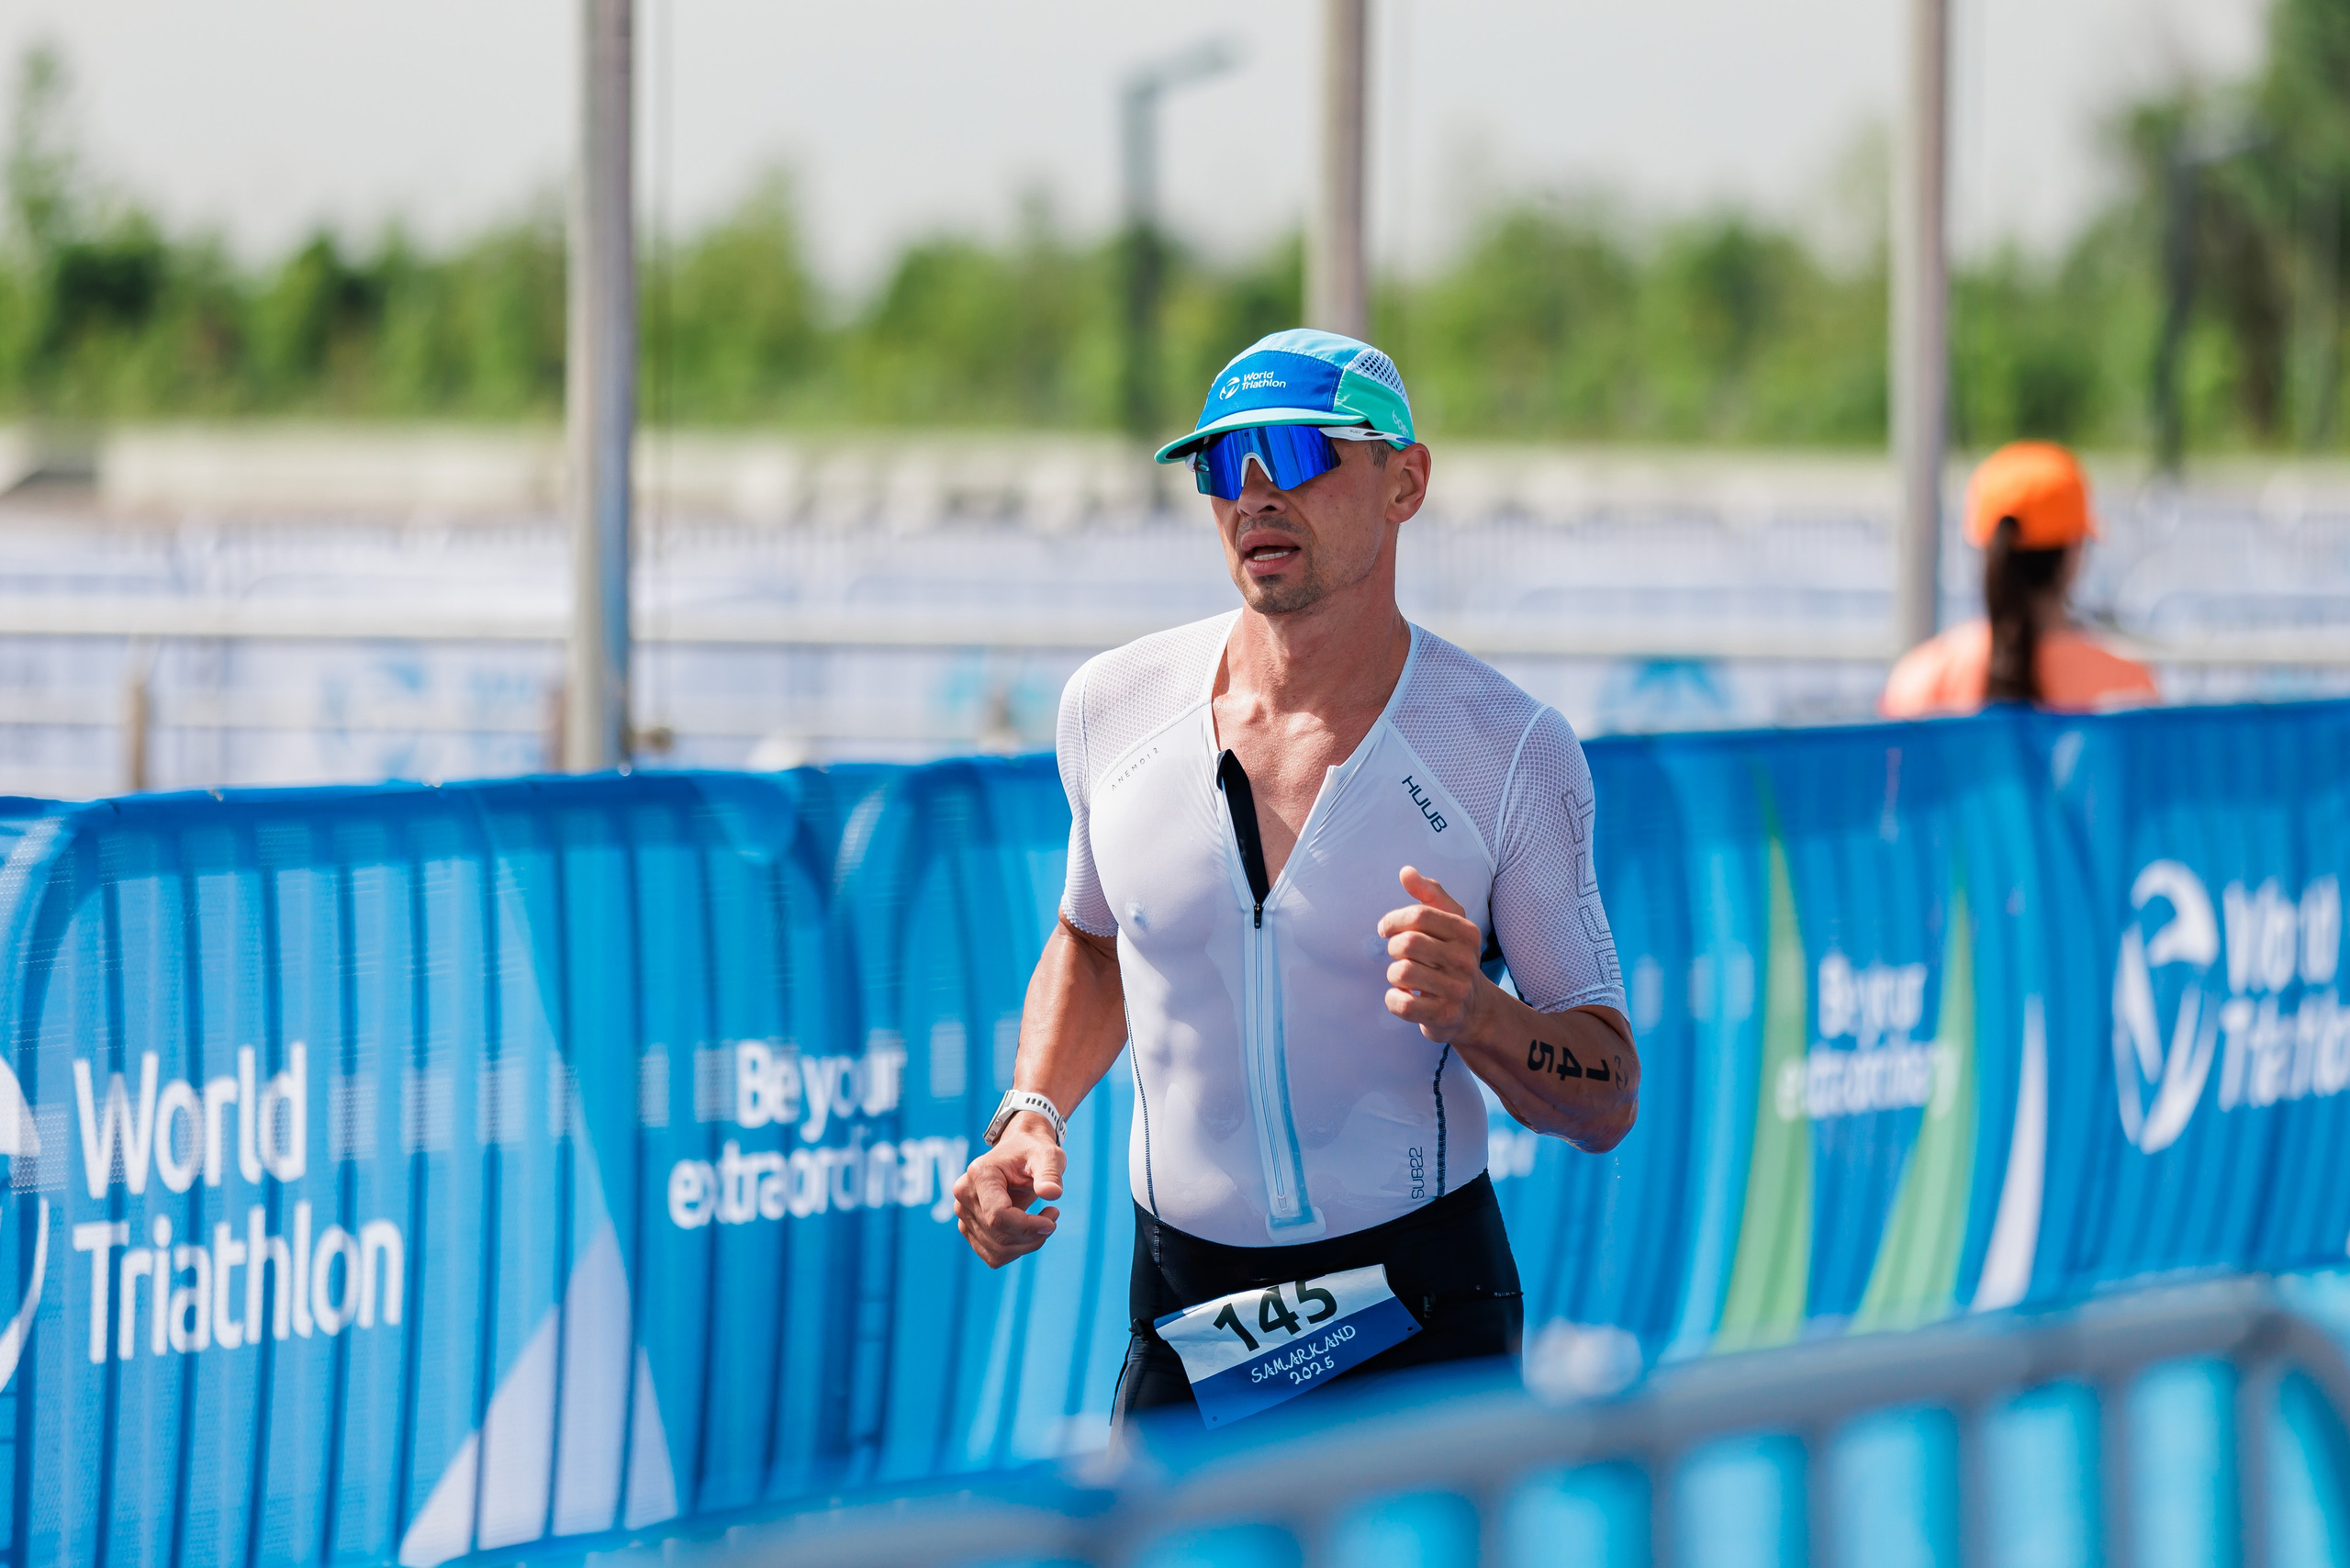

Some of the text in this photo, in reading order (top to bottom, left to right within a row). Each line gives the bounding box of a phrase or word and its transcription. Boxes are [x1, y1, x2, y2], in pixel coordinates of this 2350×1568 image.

[1242, 378, 1287, 391] Triathlon
[1243, 371, 1274, 383] World
[1401, 775, 1448, 833] HUUB
[1528, 1038, 1611, 1082] 145
[73, 1040, 308, 1199] World
[736, 1038, 908, 1144] Be your
[667, 1127, 968, 1229] extraordinary
[1408, 1146, 1425, 1200] SUB22
[73, 1200, 404, 1364] Triathlon
[1213, 1280, 1337, 1352] 145
[1251, 1325, 1357, 1383] SAMARKAND
[1290, 1355, 1336, 1384] 2025
